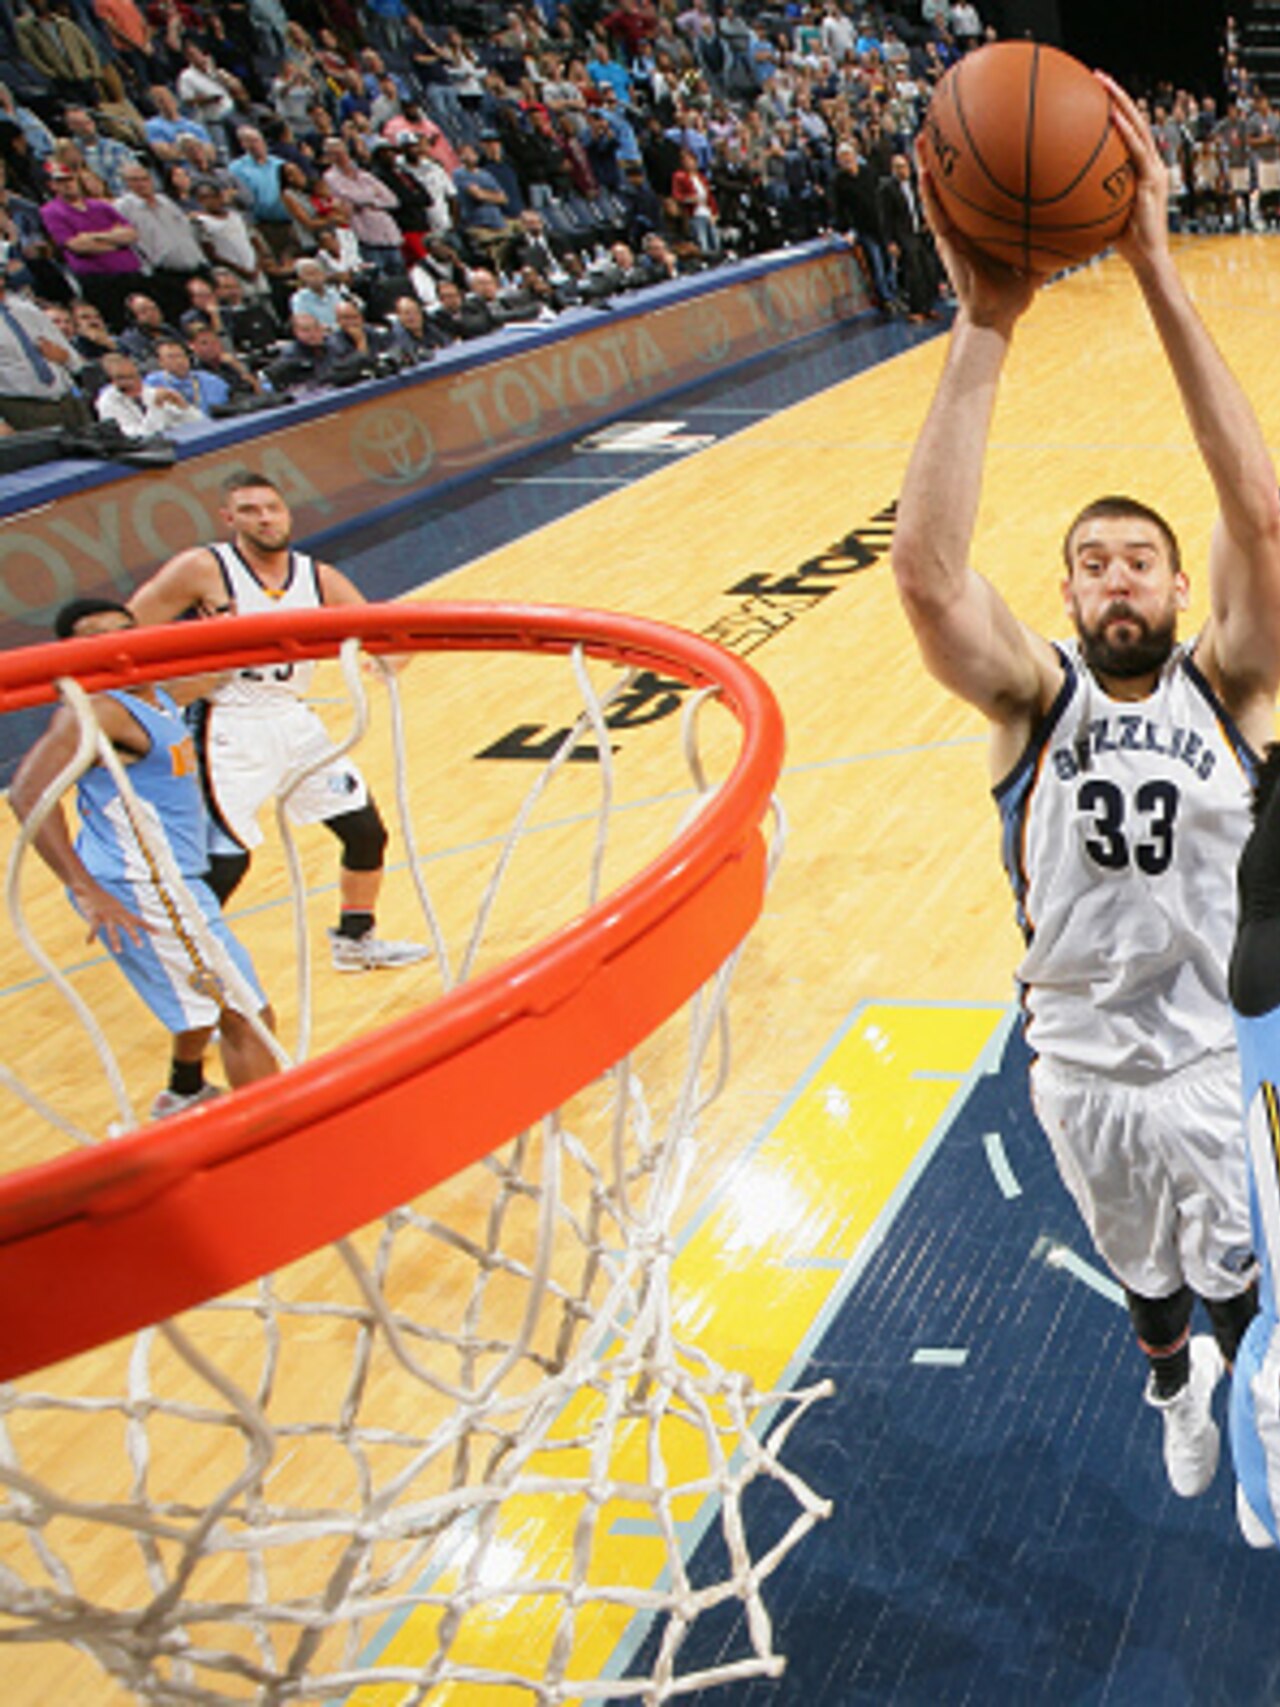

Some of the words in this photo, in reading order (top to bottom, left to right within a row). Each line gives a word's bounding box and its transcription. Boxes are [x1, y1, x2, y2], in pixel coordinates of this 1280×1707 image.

[448, 328, 678, 449] TOYOTA
[1053, 715, 1216, 781] GZZLIES
[1077, 779, 1181, 876] 33
